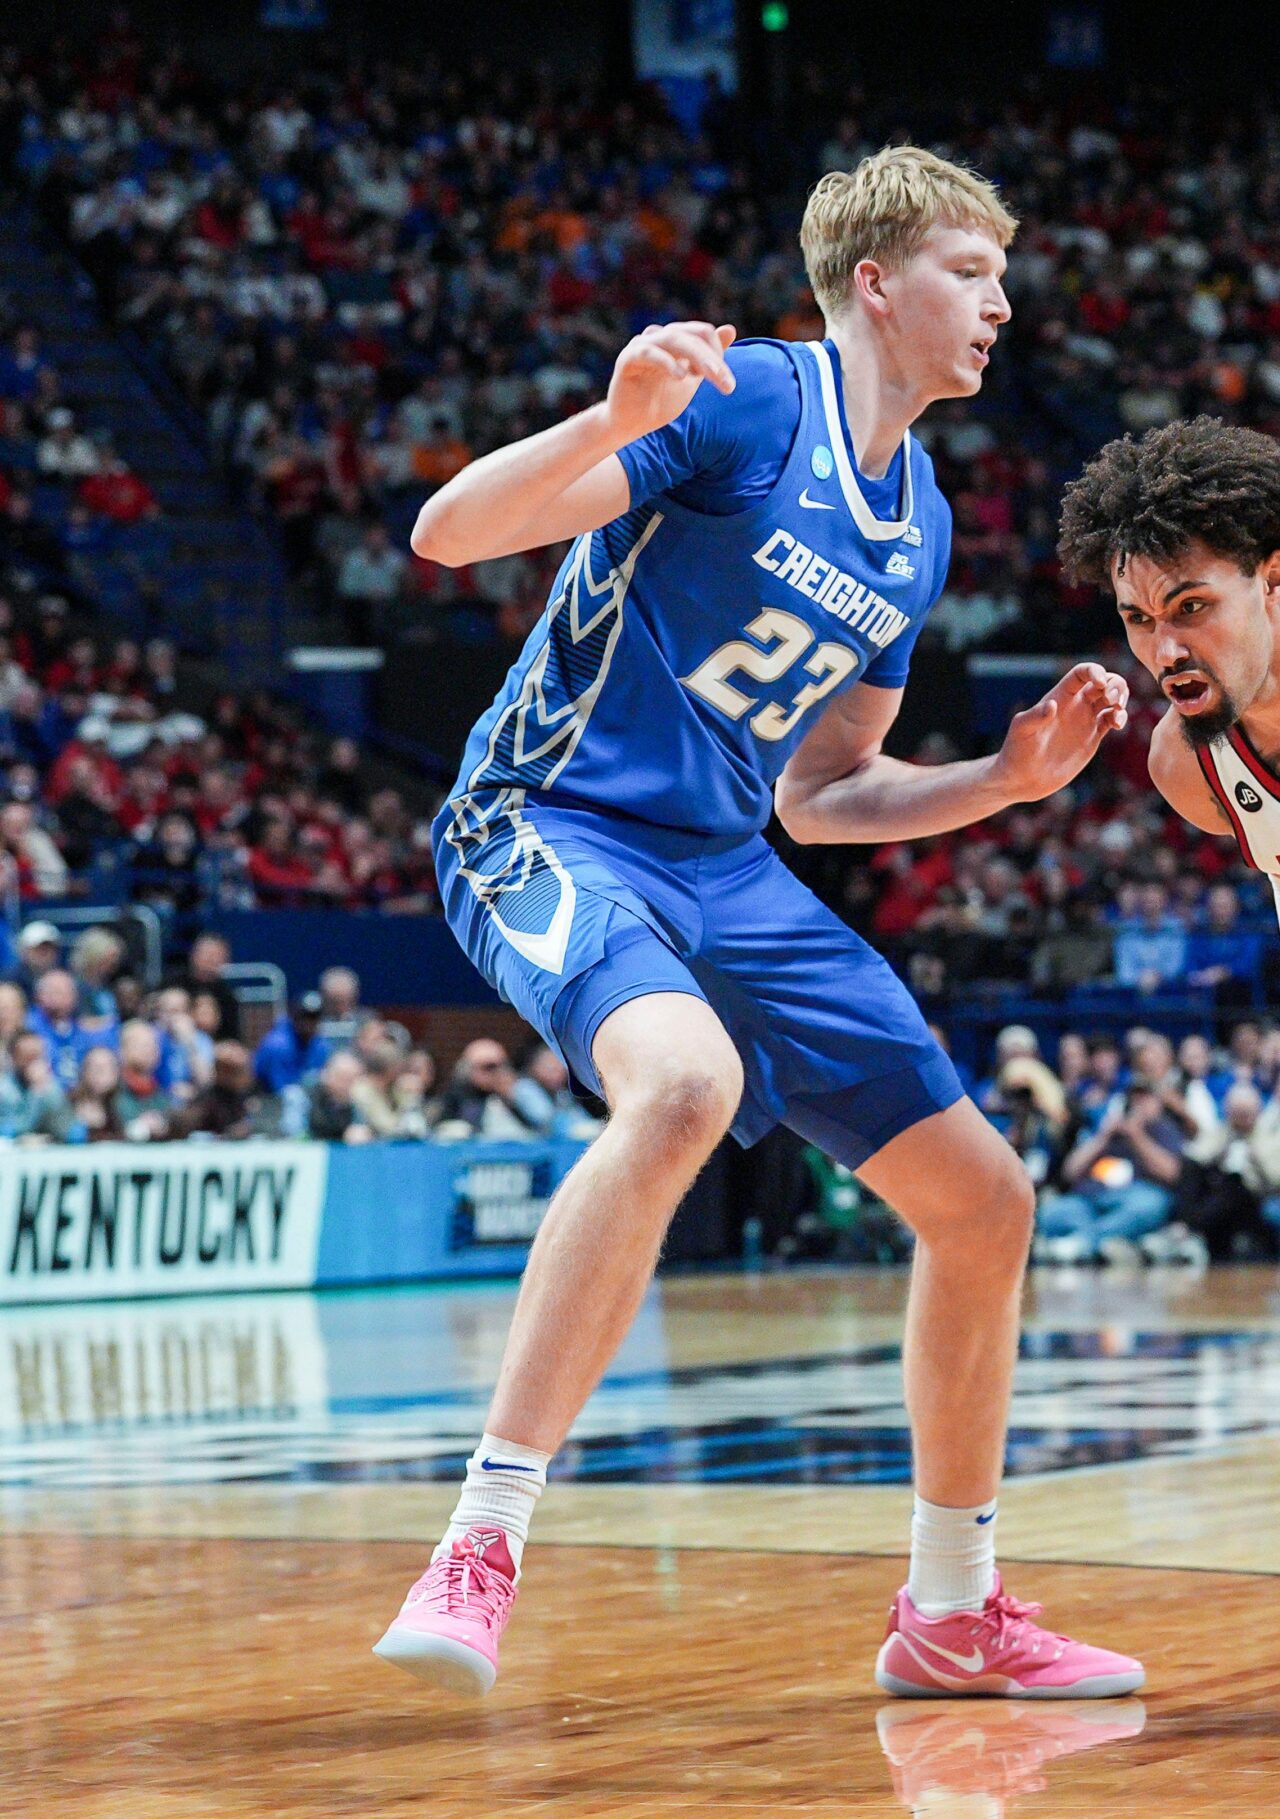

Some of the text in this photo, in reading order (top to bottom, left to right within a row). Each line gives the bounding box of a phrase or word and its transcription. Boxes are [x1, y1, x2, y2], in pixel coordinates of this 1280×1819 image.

[752, 528, 911, 649] CREIGHTON
[886, 560, 916, 576] EAST
[677, 607, 859, 741] 23
[1240, 788, 1259, 805] JB
[9, 1163, 297, 1275] KENTUCKY
